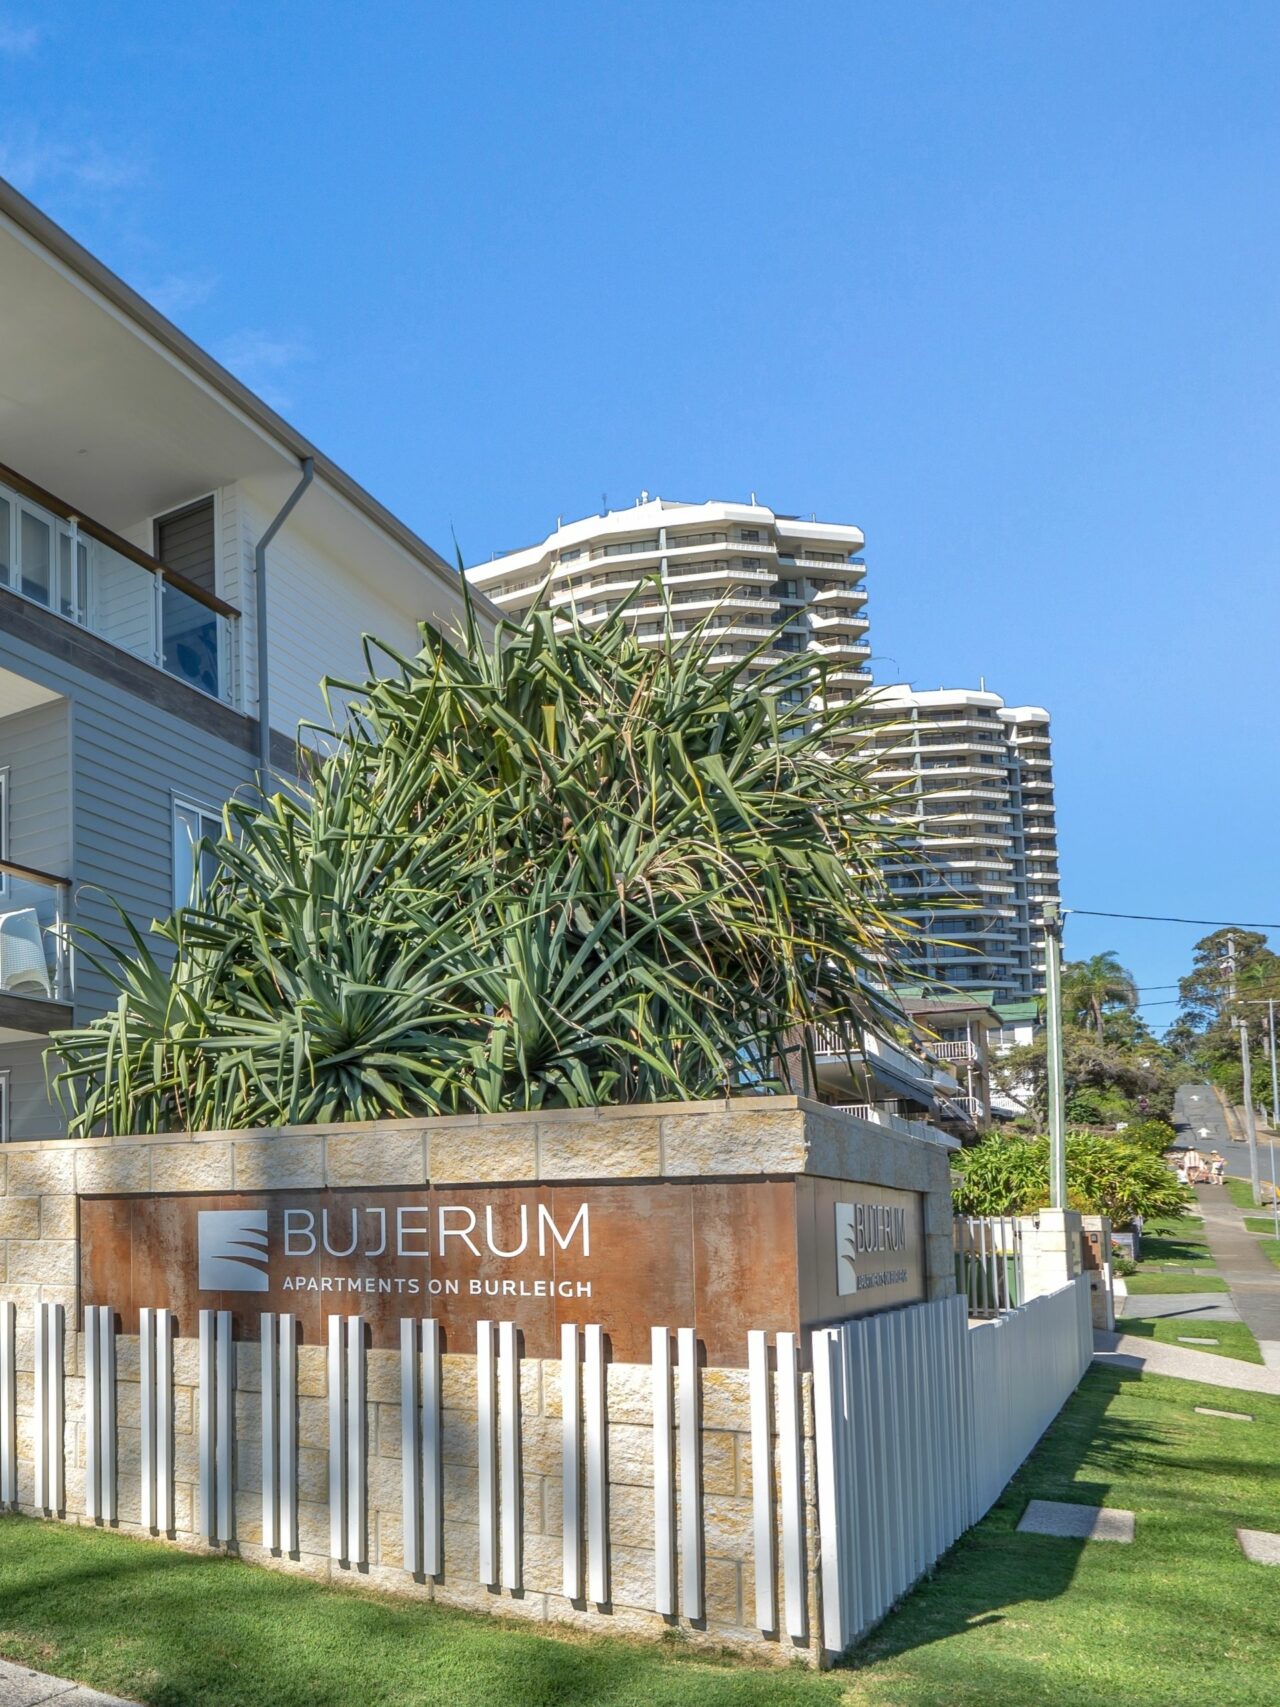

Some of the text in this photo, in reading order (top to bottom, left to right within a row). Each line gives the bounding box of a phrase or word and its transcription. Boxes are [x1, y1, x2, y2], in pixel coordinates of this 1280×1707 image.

[284, 1203, 590, 1257] BUJERUM
[855, 1204, 905, 1252] BUJERUM
[282, 1276, 591, 1298] APARTMENTS ON BURLEIGH
